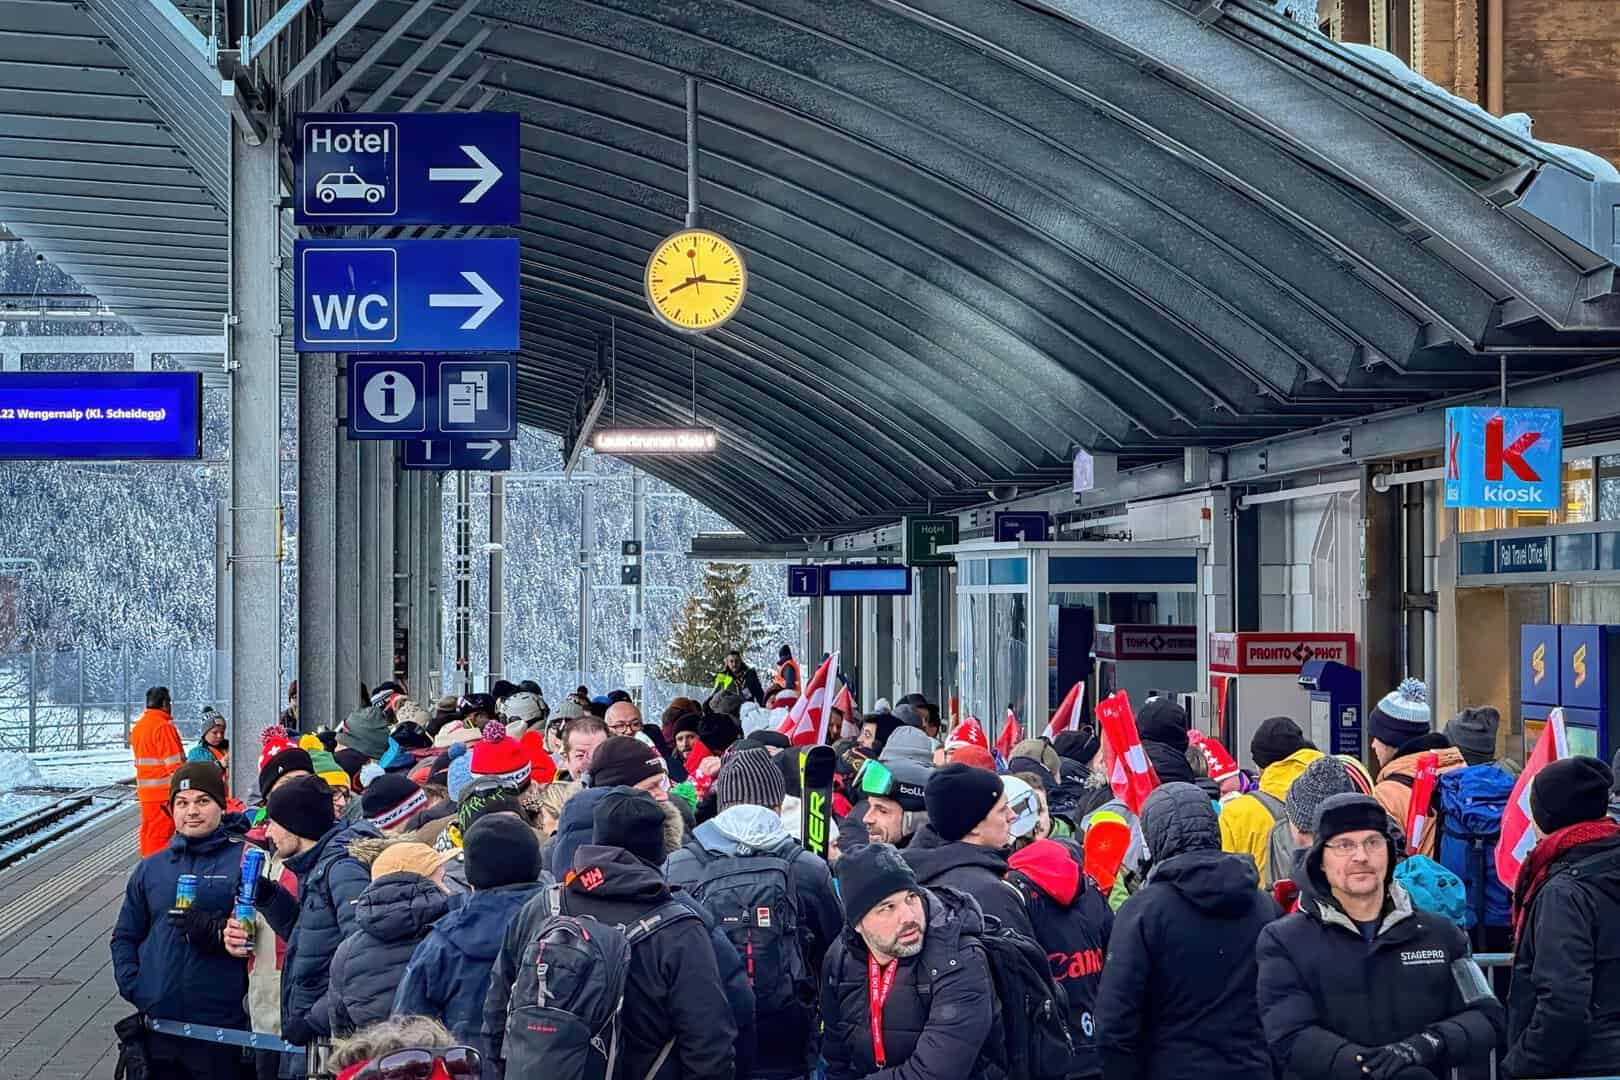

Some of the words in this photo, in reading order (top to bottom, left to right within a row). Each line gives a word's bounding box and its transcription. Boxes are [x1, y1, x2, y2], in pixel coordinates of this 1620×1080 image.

[312, 129, 390, 153] Hotel
[312, 294, 388, 331] WC
[17, 408, 83, 421] Wengernalp
[106, 408, 166, 421] Scheidegg)
[421, 439, 432, 460] 1
[1485, 416, 1542, 481] k
[1484, 485, 1543, 503] kiosk
[921, 524, 945, 535] Hotel
[1512, 544, 1527, 566] Travel
[1528, 543, 1542, 565] Office
[800, 575, 808, 592] 1
[1250, 648, 1291, 660] PRONTO
[1314, 648, 1342, 660] PHOT
[1046, 947, 1104, 981] Can
[1400, 950, 1445, 961] STAGEPRO
